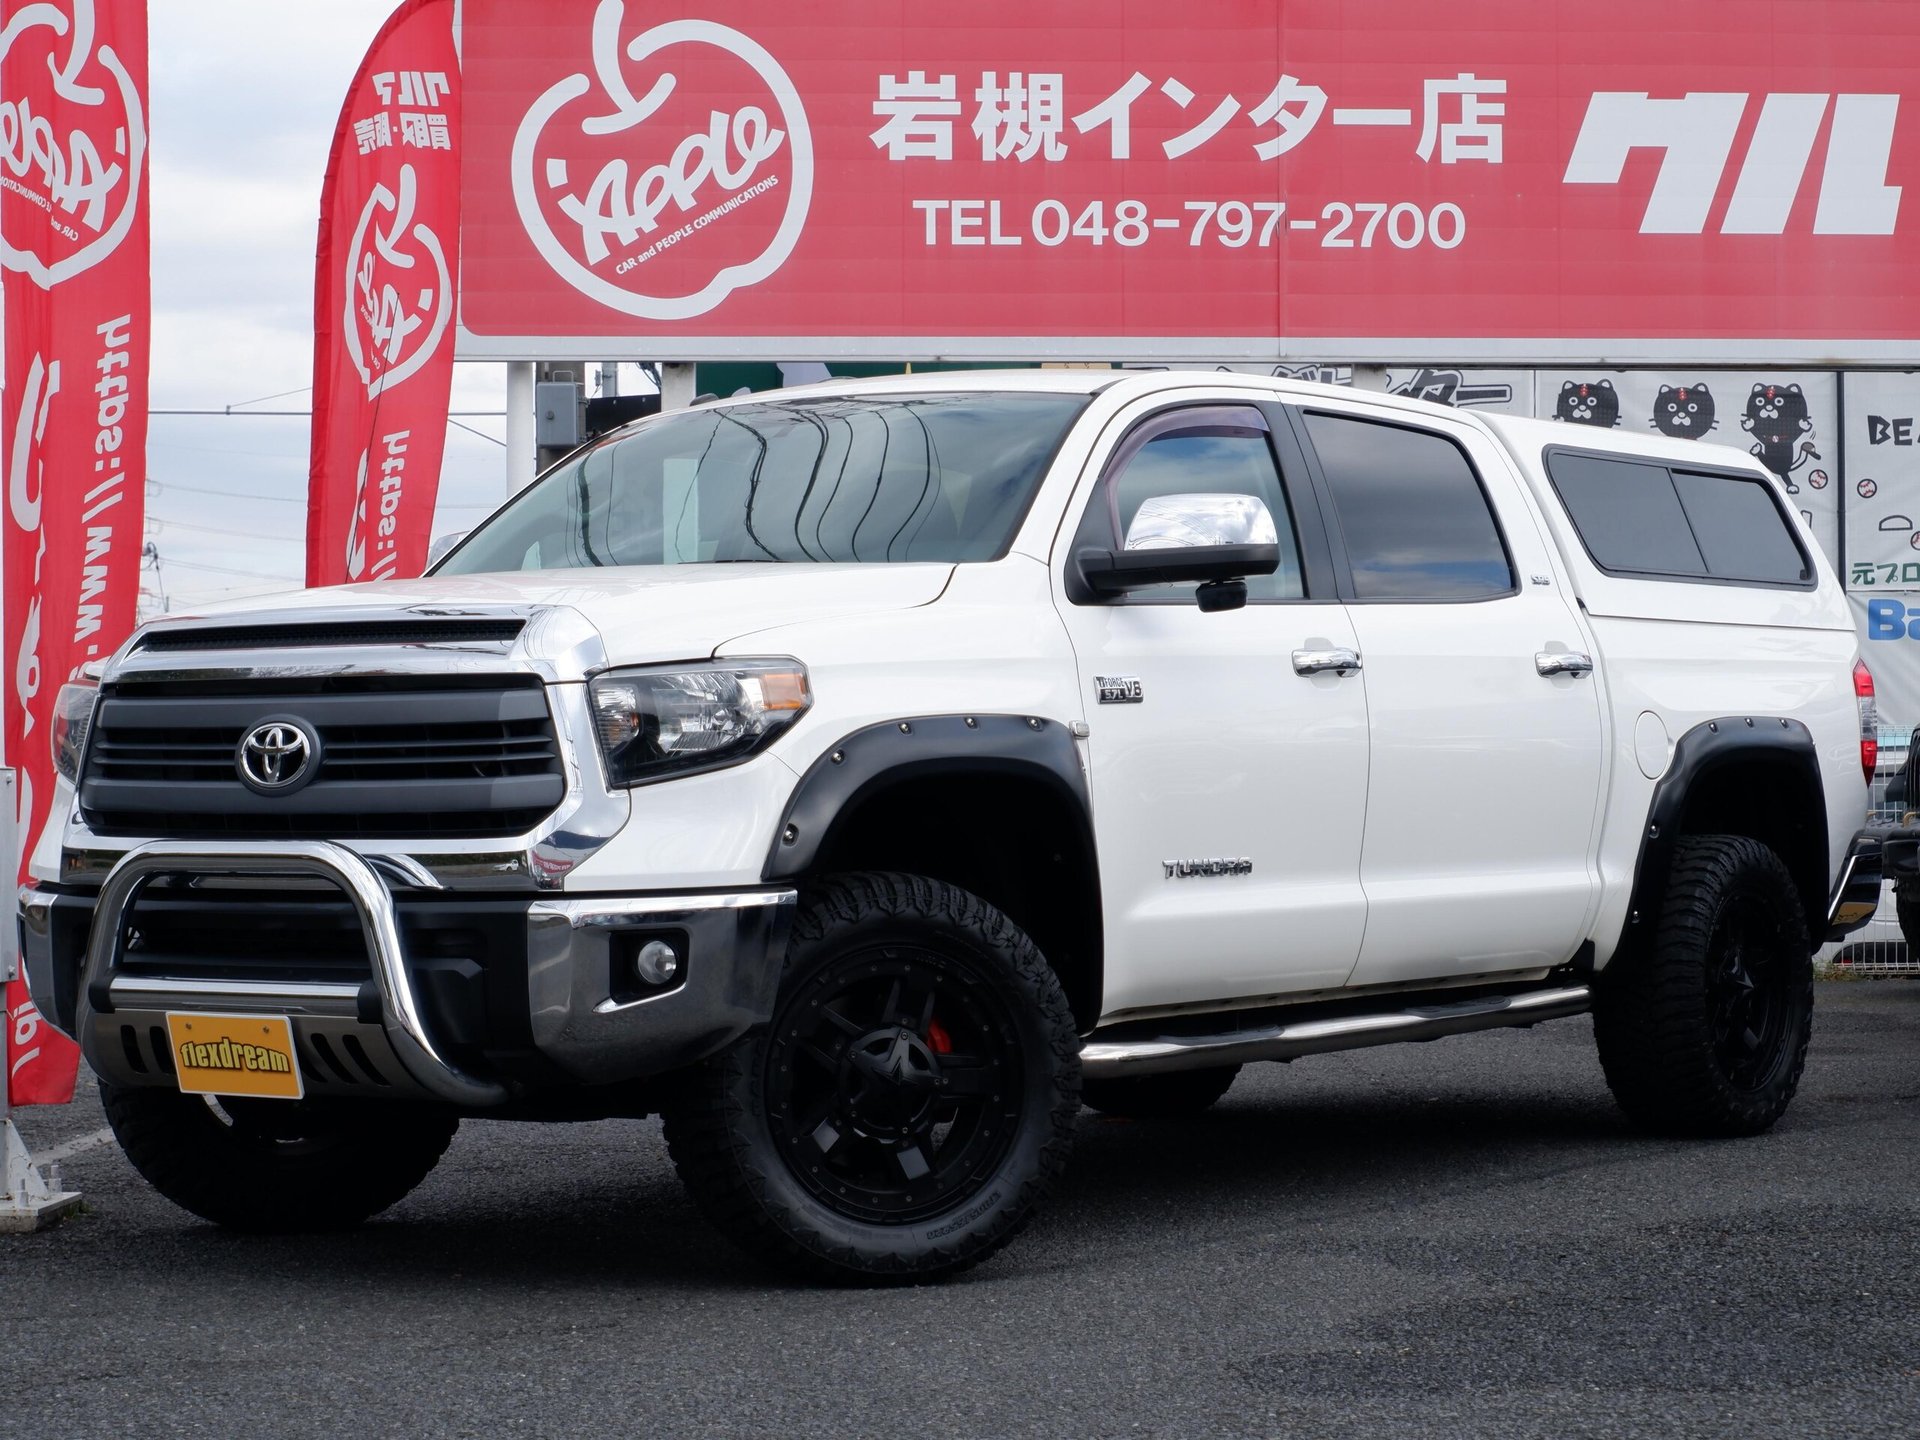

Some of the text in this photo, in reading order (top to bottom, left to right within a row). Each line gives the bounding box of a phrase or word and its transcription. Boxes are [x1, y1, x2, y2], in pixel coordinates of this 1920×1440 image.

[869, 71, 1507, 164] 岩槻インター店
[557, 105, 786, 266] Apple
[615, 174, 779, 275] CAR and PEOPLE COMMUNICATIONS
[912, 199, 1467, 249] TEL 048-797-2700
[1867, 415, 1920, 446] BE
[1162, 856, 1253, 880] TUNDRA
[180, 1037, 291, 1073] flexdream
